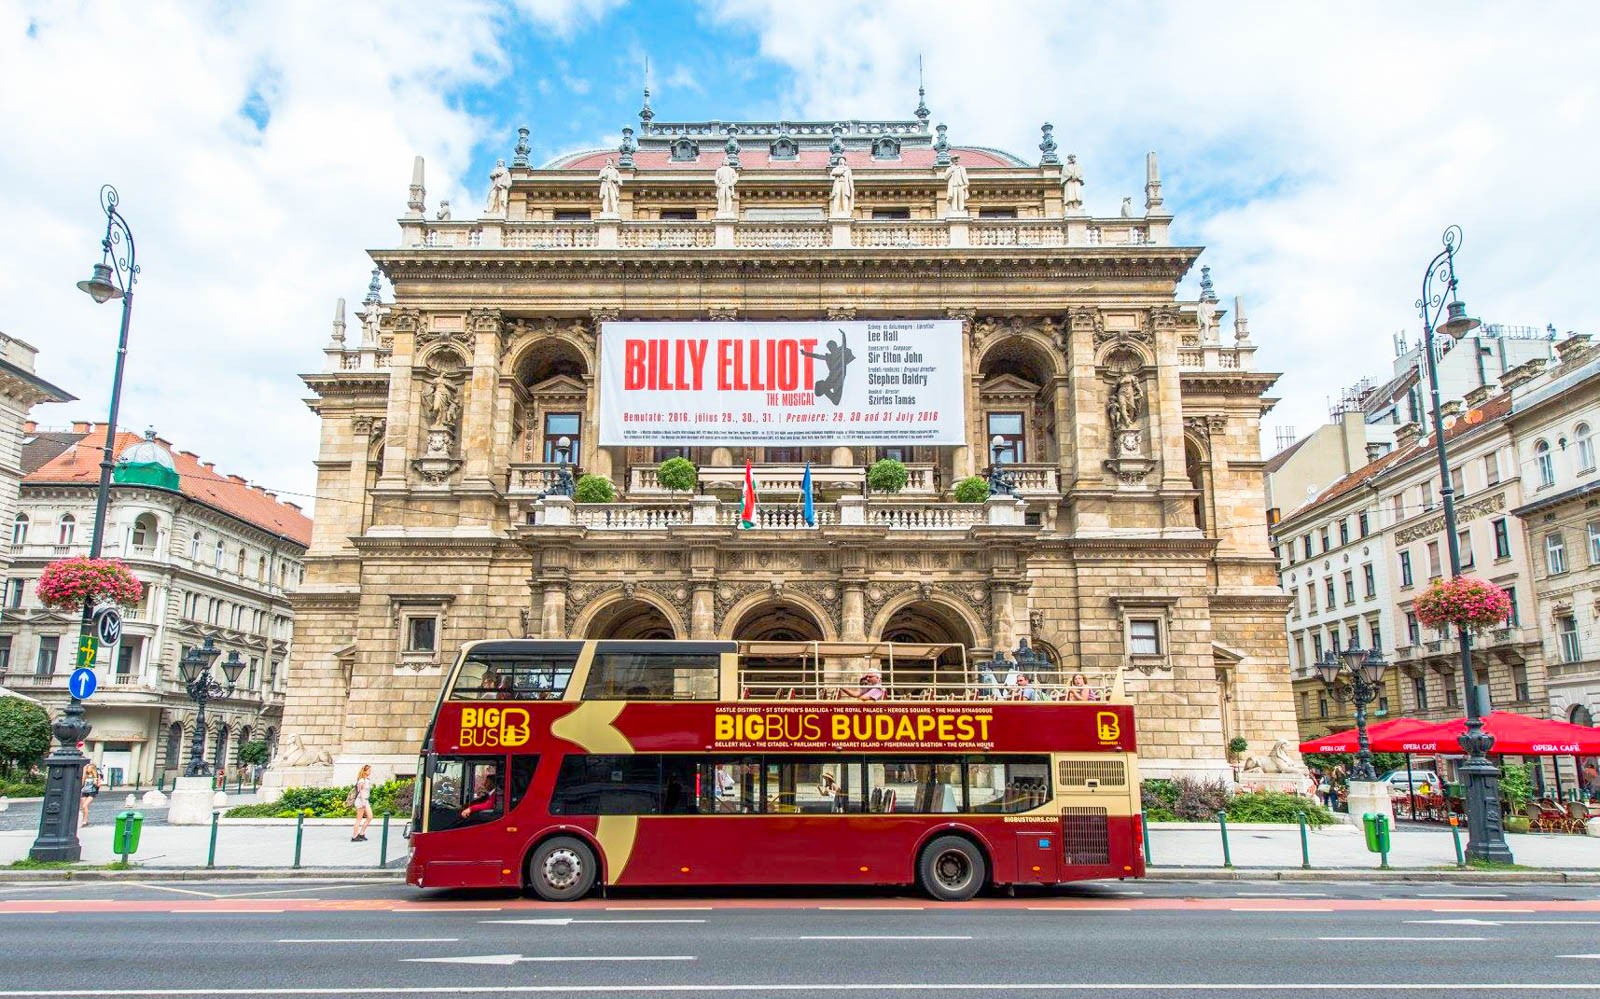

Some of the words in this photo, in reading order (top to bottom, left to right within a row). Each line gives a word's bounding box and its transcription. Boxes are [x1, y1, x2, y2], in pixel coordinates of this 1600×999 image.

[868, 331, 881, 342] Lee
[883, 331, 898, 342] Hall
[868, 352, 880, 363] Sir
[883, 352, 902, 363] Elton
[904, 352, 923, 363] John
[624, 339, 709, 391] BILLY
[717, 339, 818, 392] ELLIOT
[868, 373, 900, 386] Stephen
[902, 373, 928, 386] Daldry
[767, 393, 779, 406] THE
[782, 393, 816, 406] MUSICAL
[868, 394, 893, 405] Szirtes
[895, 394, 916, 405] Tamás
[623, 412, 665, 422] Bemutató:
[668, 412, 691, 422] 2016.
[850, 412, 861, 422] 30
[865, 412, 879, 422] and
[882, 412, 892, 422] 31
[896, 411, 914, 423] July
[917, 411, 938, 422] 2016
[461, 708, 500, 728] BIG
[715, 714, 821, 740] BIGBUS
[831, 714, 993, 741] BUDAPEST
[460, 728, 499, 747] BUS
[1421, 742, 1437, 750] CAFÉ
[1560, 742, 1581, 751] CAFÉ
